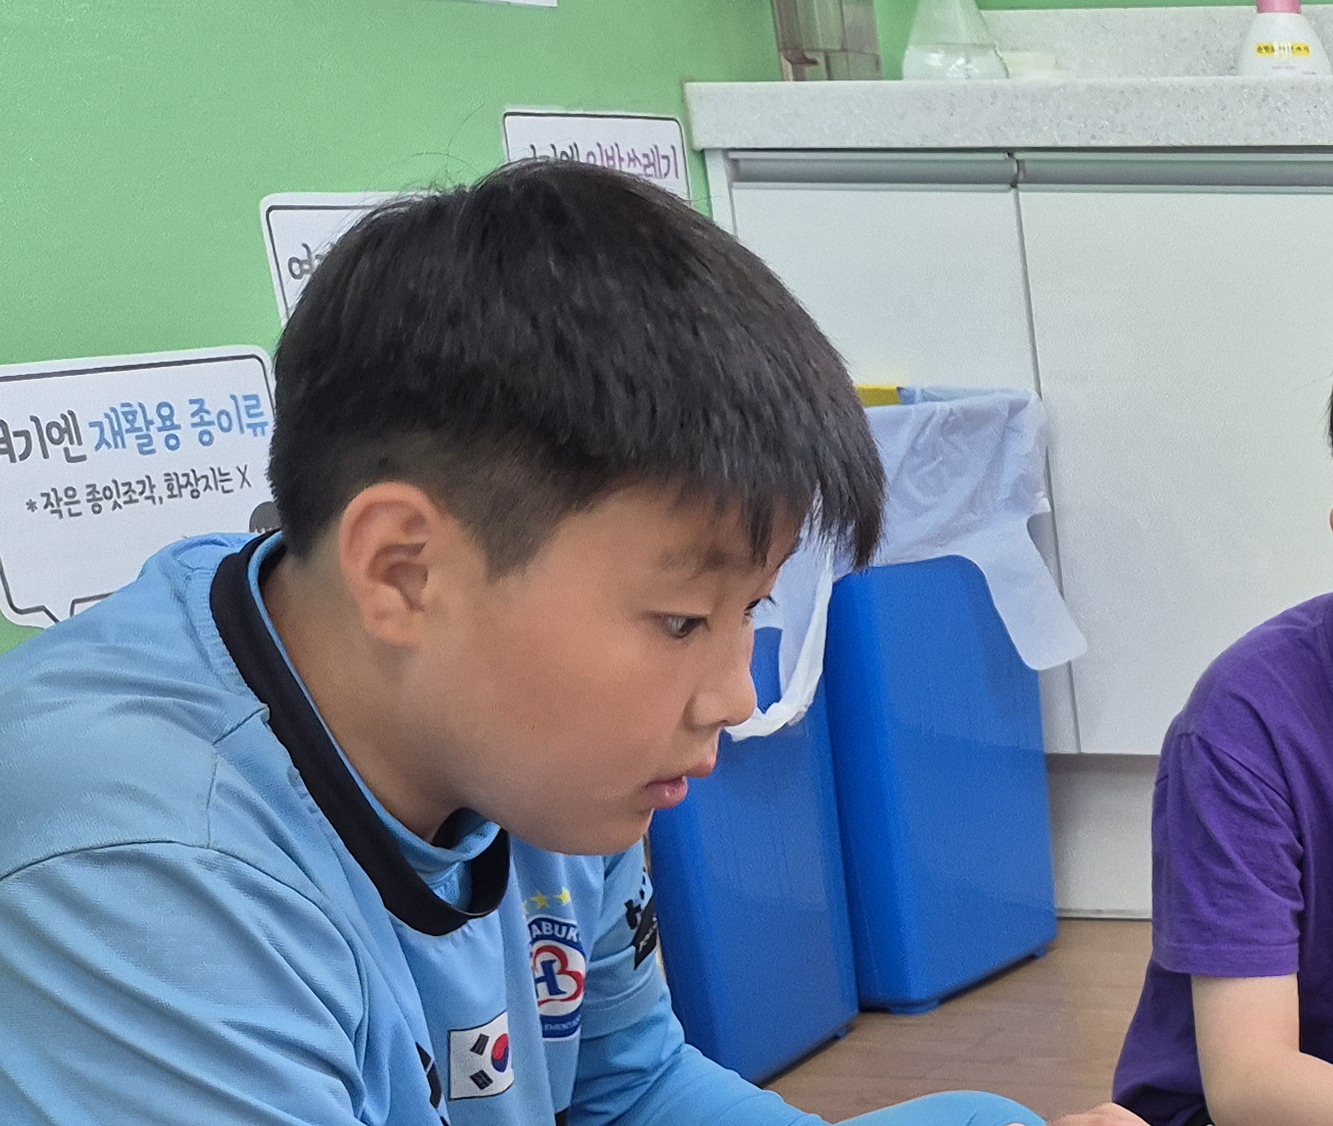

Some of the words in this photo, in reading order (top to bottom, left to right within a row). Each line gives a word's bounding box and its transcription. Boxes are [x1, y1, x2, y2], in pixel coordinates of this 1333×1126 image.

[88, 401, 182, 457] 재활용
[188, 393, 269, 448] 종이류
[40, 486, 83, 520] 작은
[85, 474, 163, 516] 종잇조각,
[162, 464, 233, 500] 화장지는
